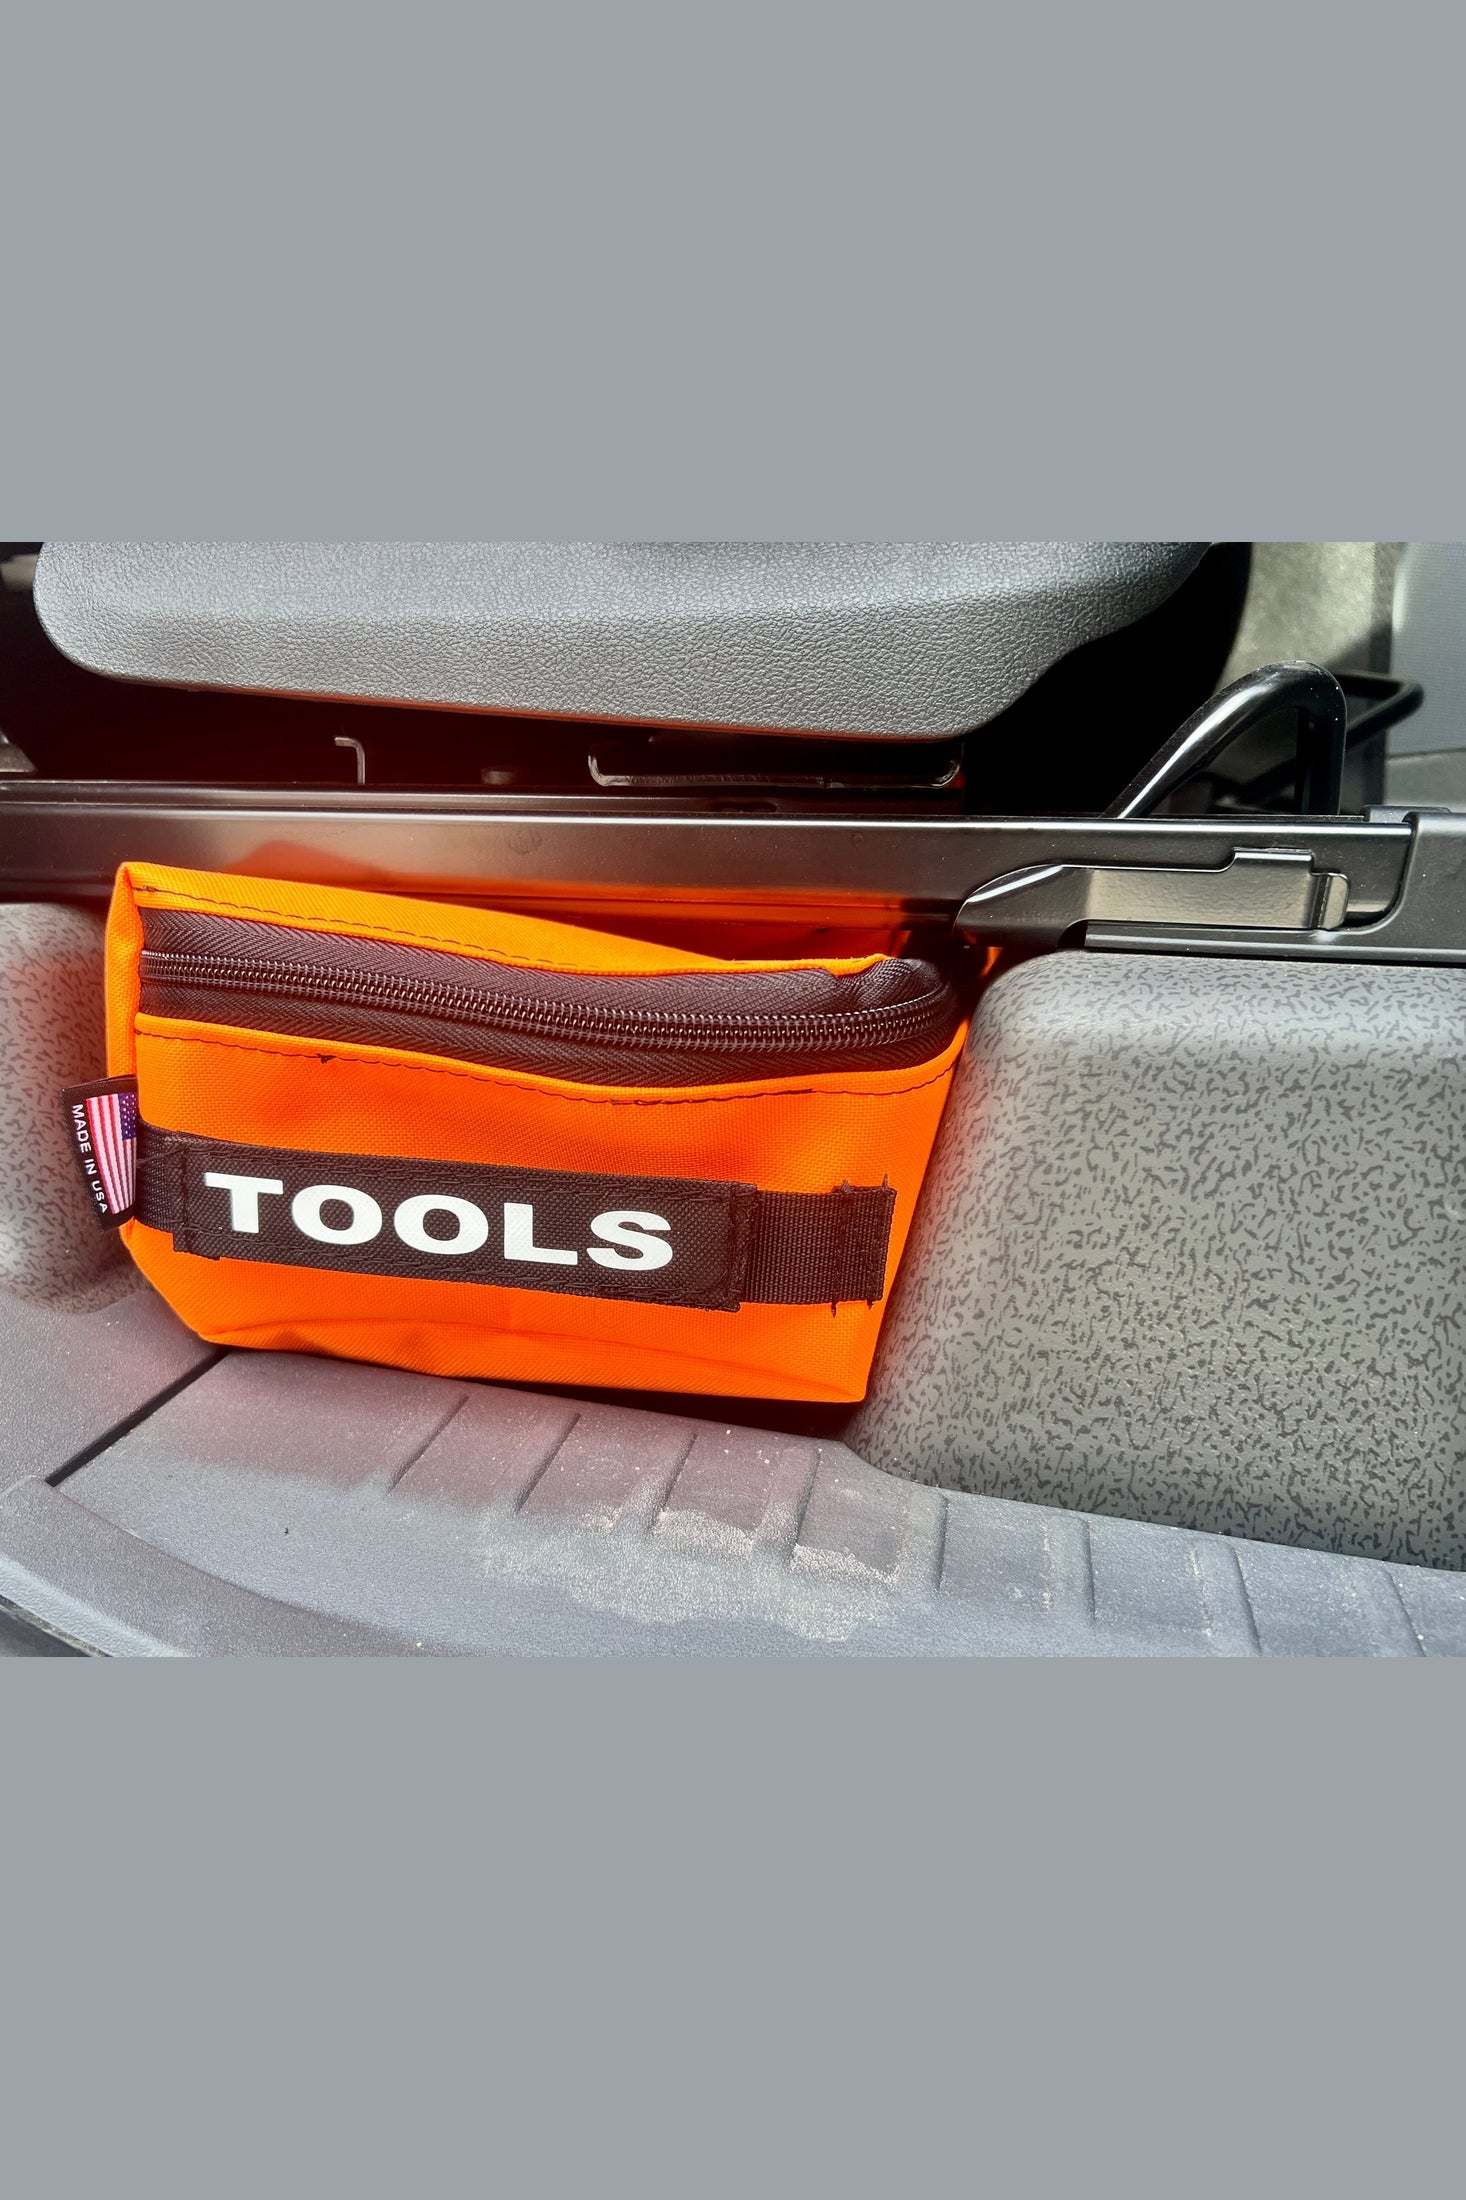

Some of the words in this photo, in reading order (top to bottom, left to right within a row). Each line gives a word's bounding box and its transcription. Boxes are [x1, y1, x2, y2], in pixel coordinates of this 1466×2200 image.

[72, 1104, 92, 1153] MADE
[84, 1158, 97, 1175] IN
[91, 1181, 108, 1213] USA
[203, 1171, 674, 1271] TOOLS
